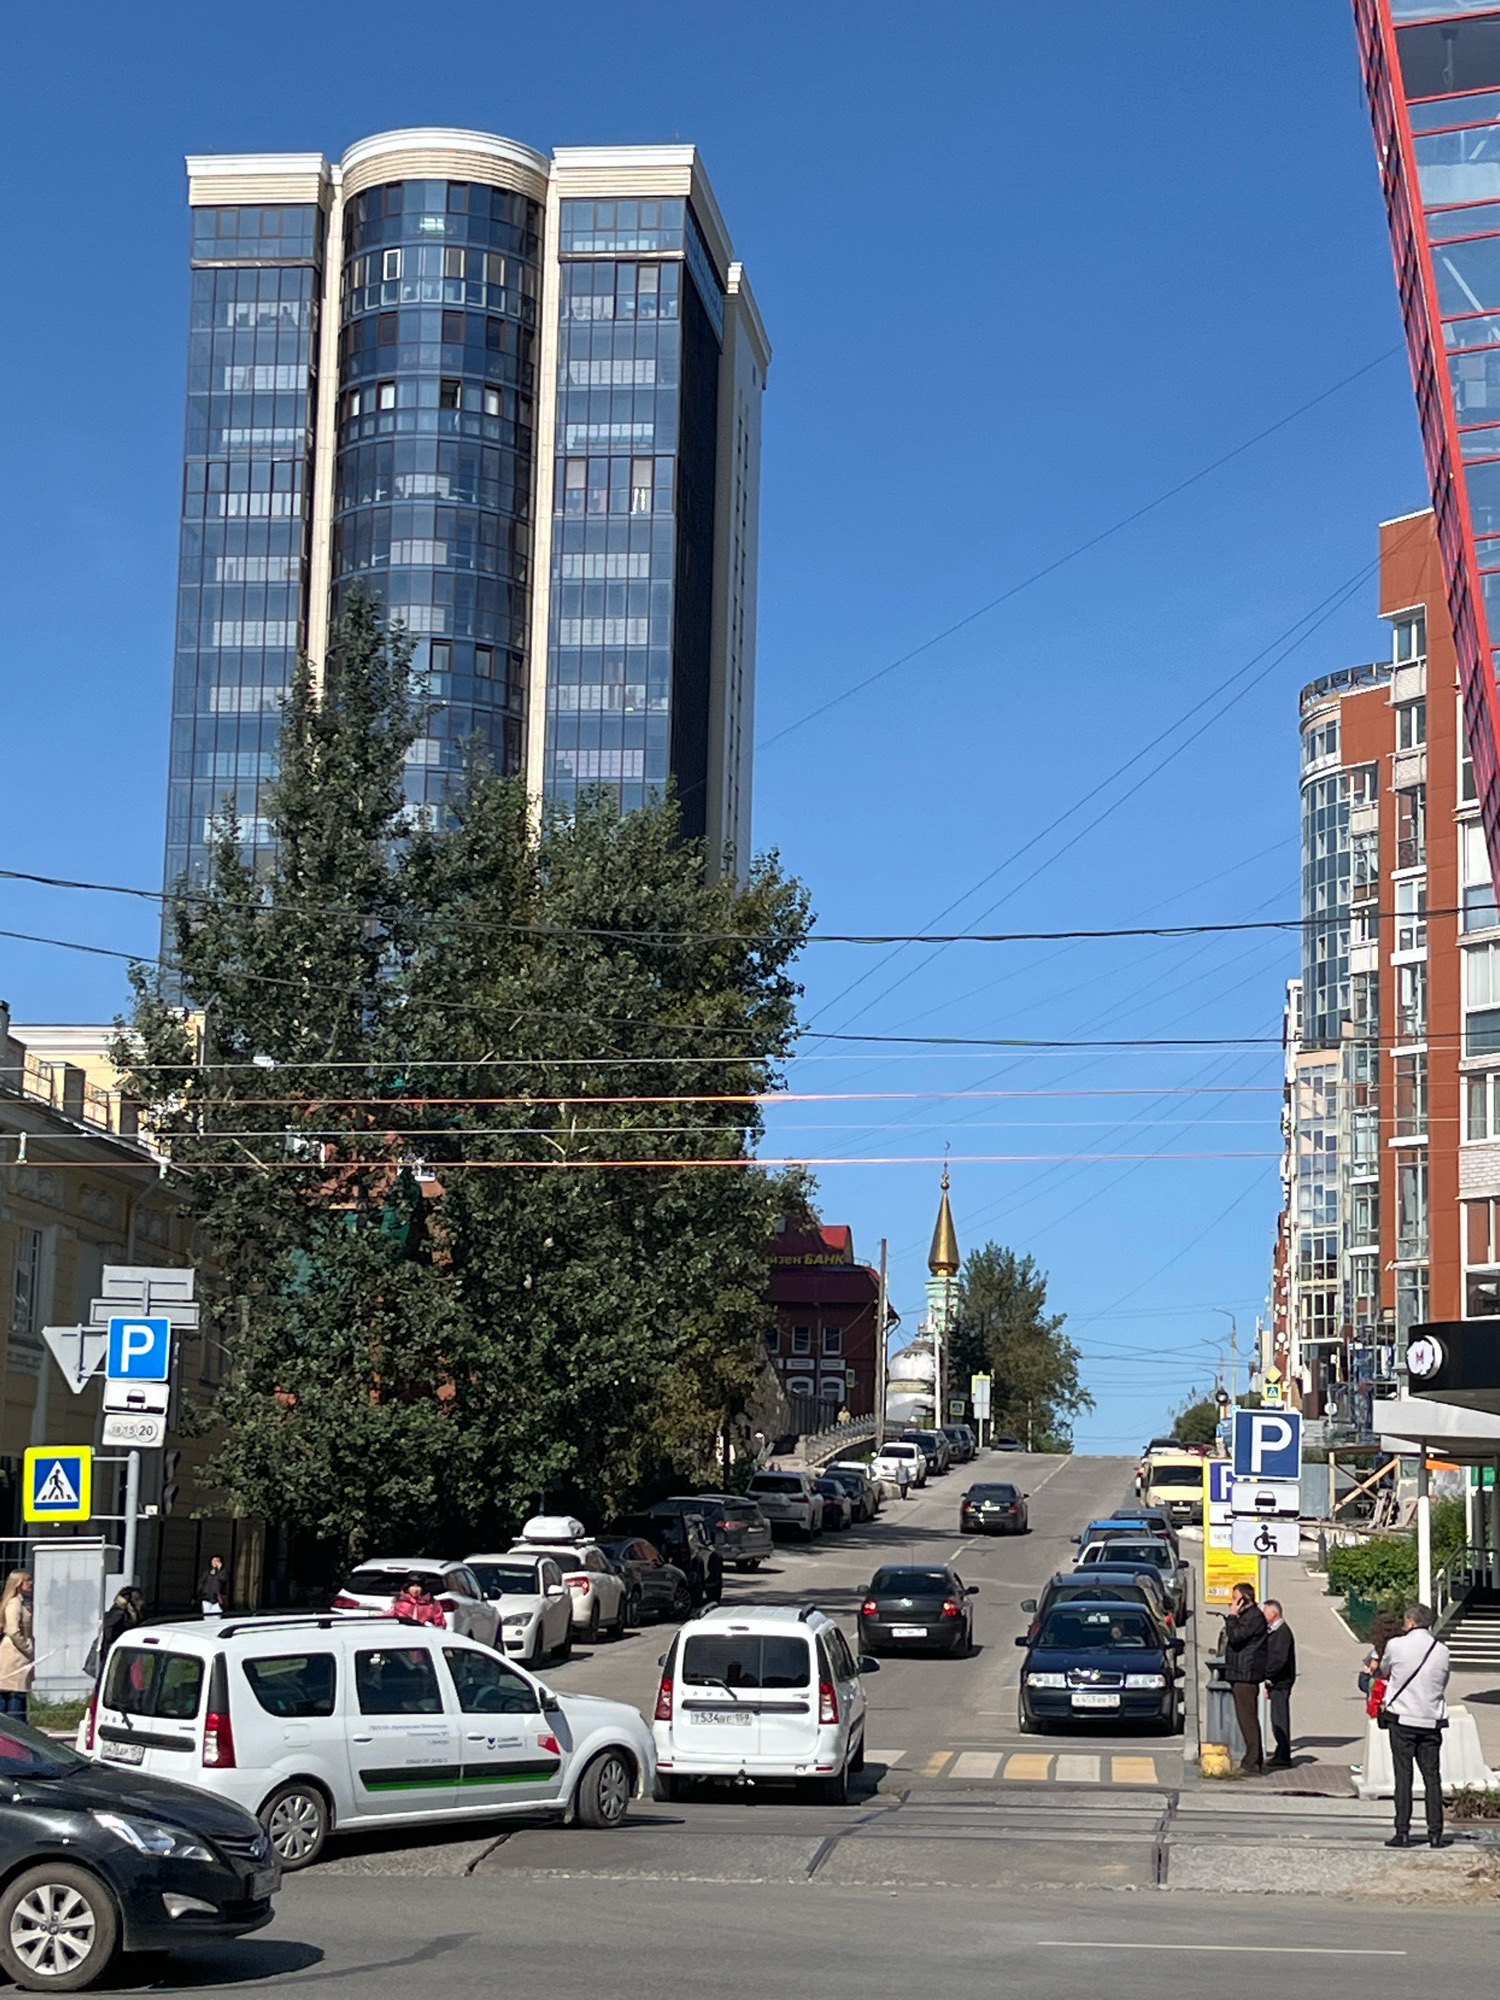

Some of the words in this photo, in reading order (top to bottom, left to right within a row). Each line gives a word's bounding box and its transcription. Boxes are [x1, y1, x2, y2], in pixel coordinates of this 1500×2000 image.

[804, 1253, 844, 1265] БАНК
[121, 1325, 155, 1372] P
[124, 1425, 135, 1435] 15
[139, 1425, 153, 1436] 20
[1252, 1416, 1292, 1472] P
